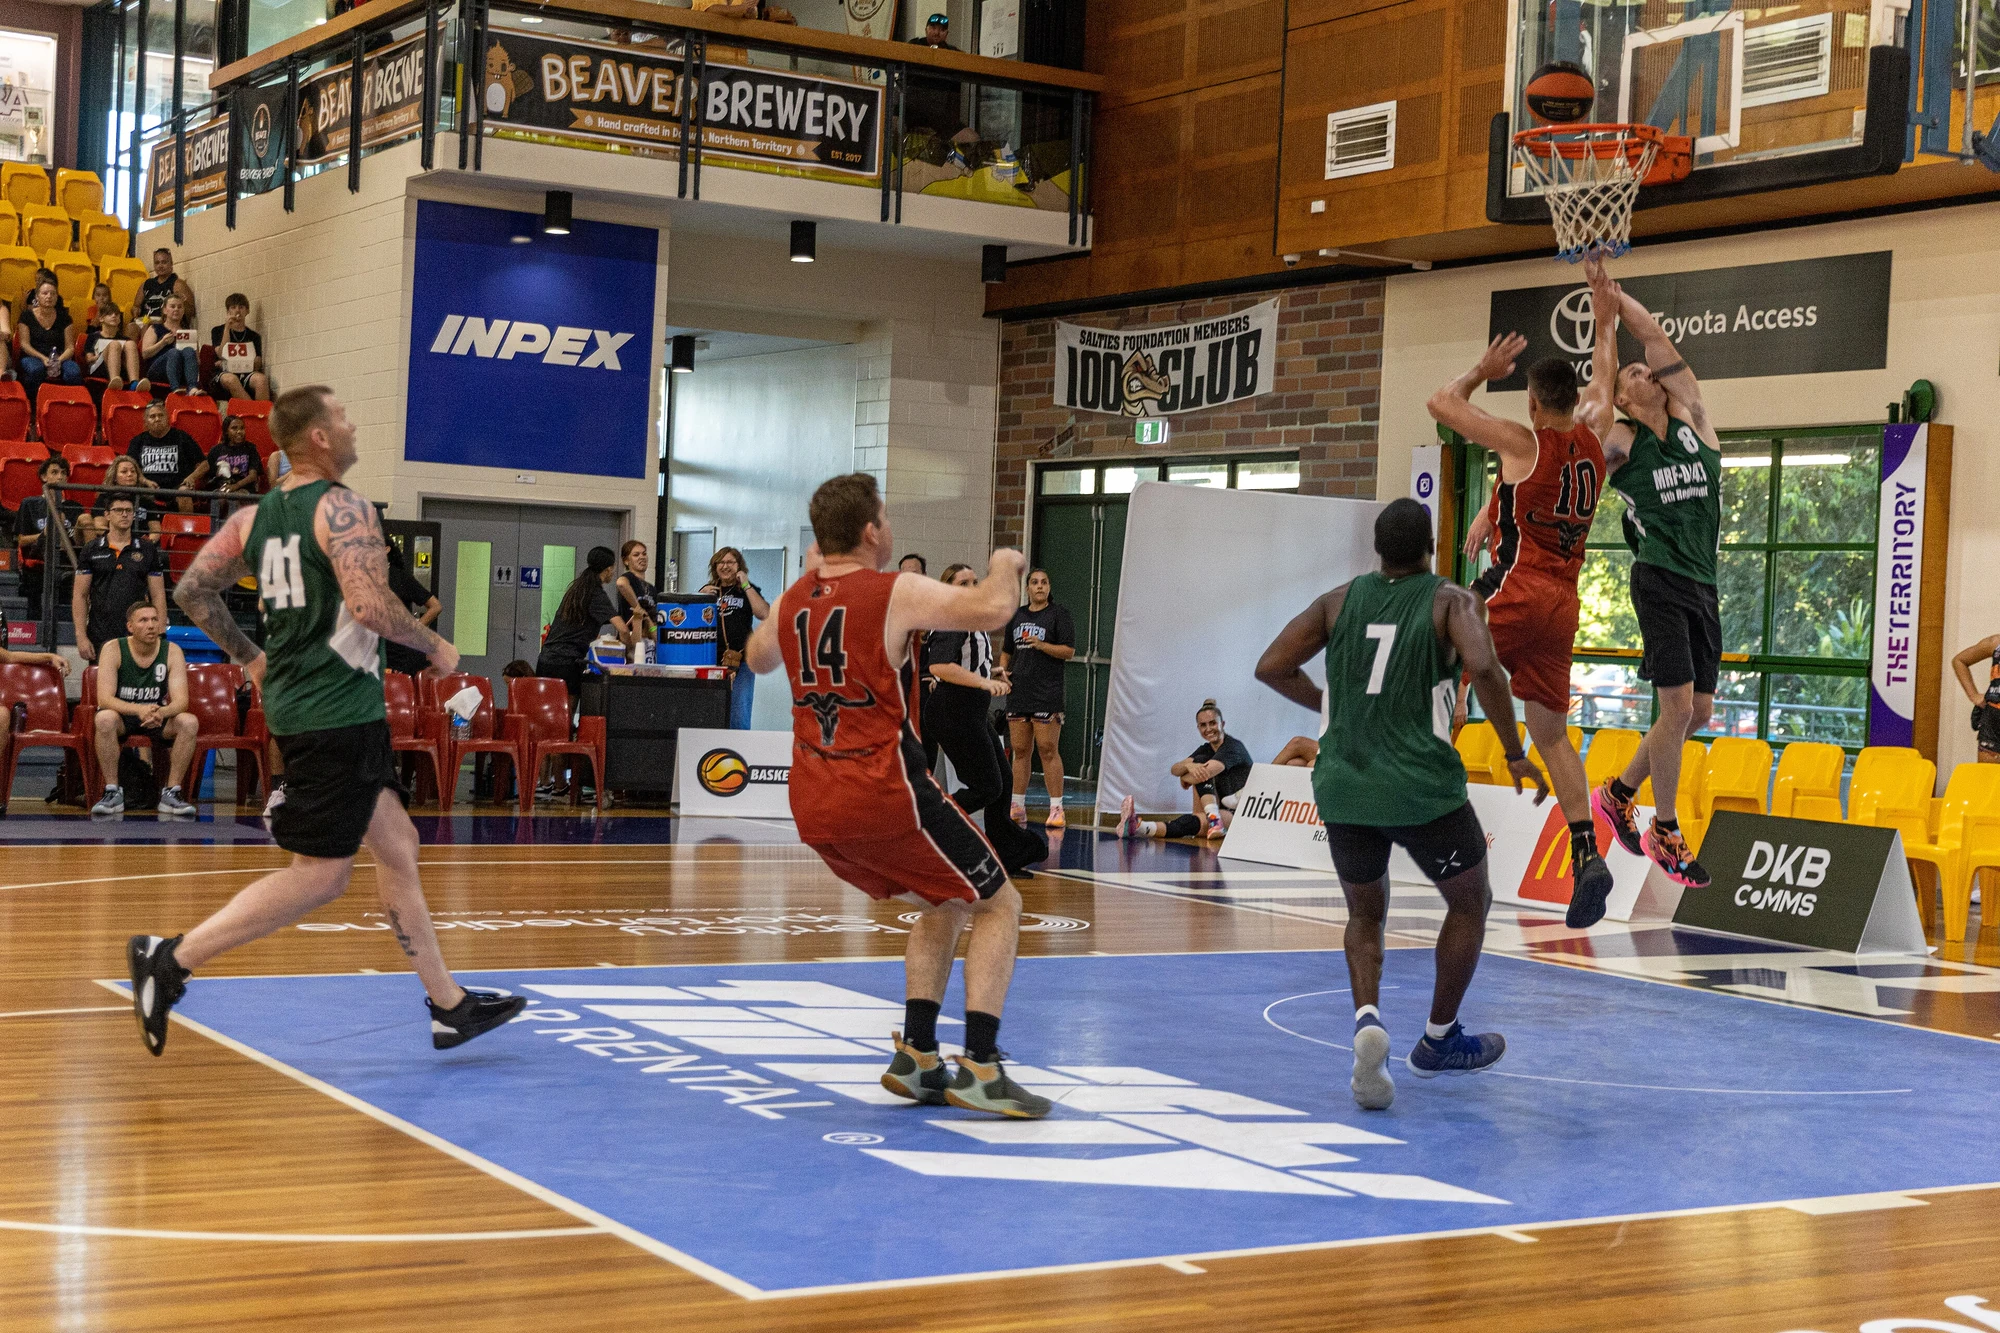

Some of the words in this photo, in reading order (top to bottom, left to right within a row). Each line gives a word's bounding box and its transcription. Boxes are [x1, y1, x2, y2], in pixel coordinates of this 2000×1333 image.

[318, 74, 374, 134] BEAVR
[373, 49, 424, 110] BREWE
[542, 54, 698, 119] BEAVER
[706, 81, 869, 143] BREWERY
[597, 116, 621, 131] Hand
[623, 122, 660, 137] crafted
[662, 126, 670, 137] in
[709, 132, 749, 149] Northern
[752, 137, 792, 156] Territory
[830, 149, 848, 161] EST.
[845, 152, 862, 164] 2017
[158, 142, 194, 187] BEAR
[430, 314, 636, 371] INPEX
[1079, 330, 1120, 351] SALTIES
[1122, 331, 1190, 351] FOUNDATION
[1193, 315, 1250, 341] MEMBERS
[1651, 310, 1727, 343] Toyota
[1732, 304, 1818, 333] Access
[1067, 345, 1124, 412] 100
[1158, 328, 1263, 412] CLUB
[1677, 425, 1699, 454] 8
[1553, 458, 1597, 519] 10
[260, 534, 306, 609] 41
[794, 606, 848, 686] 14
[1366, 624, 1397, 695] 7
[120, 686, 144, 701] MRF-D
[155, 663, 167, 683] 9
[1241, 791, 1325, 827] nickmou
[1742, 840, 1831, 888] DKB
[534, 1026, 836, 1120] RENTAL
